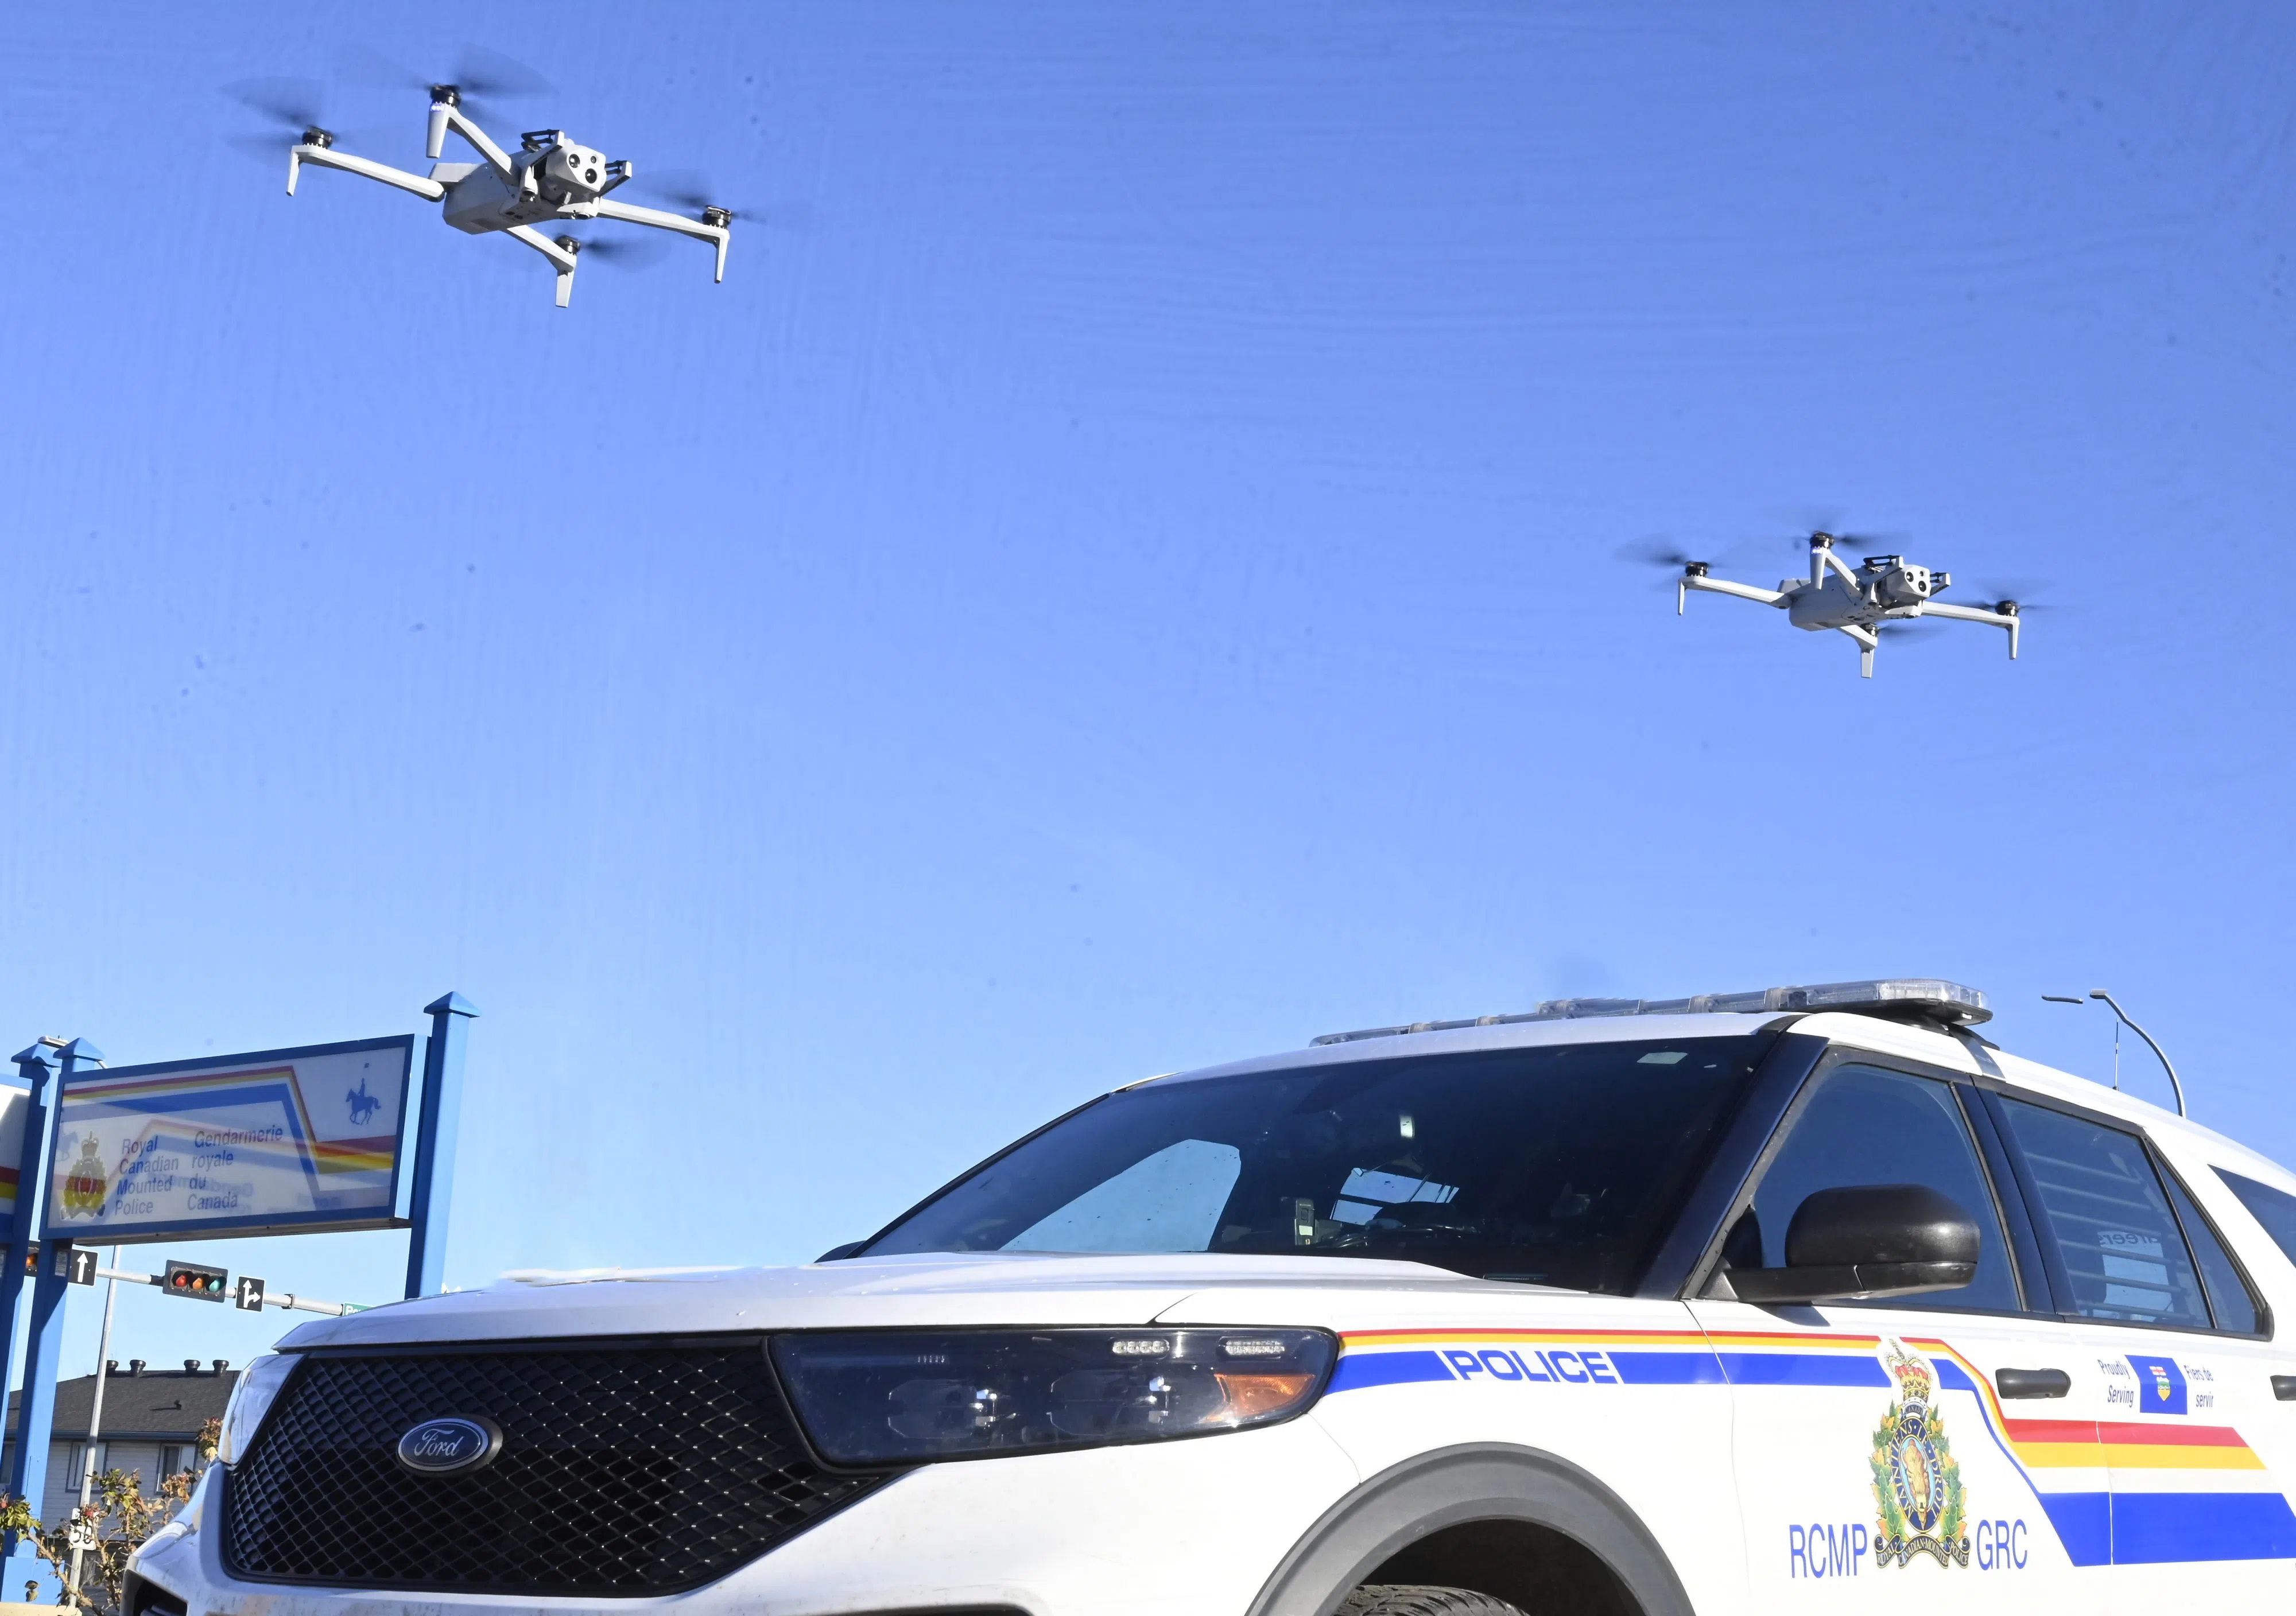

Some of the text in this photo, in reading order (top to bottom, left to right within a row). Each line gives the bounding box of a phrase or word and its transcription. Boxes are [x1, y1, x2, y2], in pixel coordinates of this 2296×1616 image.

[122, 1136, 158, 1157] Royal
[194, 1125, 283, 1148] Gendarmerie
[119, 1155, 179, 1175] Canadian
[192, 1150, 234, 1172] royale
[117, 1175, 173, 1195] Mounted
[189, 1173, 206, 1190] du
[115, 1199, 154, 1216] Police
[187, 1192, 238, 1211] Canada
[1442, 1350, 1619, 1384] POLICE
[2097, 1359, 2131, 1379] Proudly
[2183, 1365, 2214, 1381] Fiers de
[2107, 1385, 2134, 1408] Serving
[2196, 1391, 2214, 1408] servir
[414, 1428, 464, 1456] Ford
[1789, 1522, 1868, 1579] RCMP
[1976, 1518, 2028, 1571] GRC
